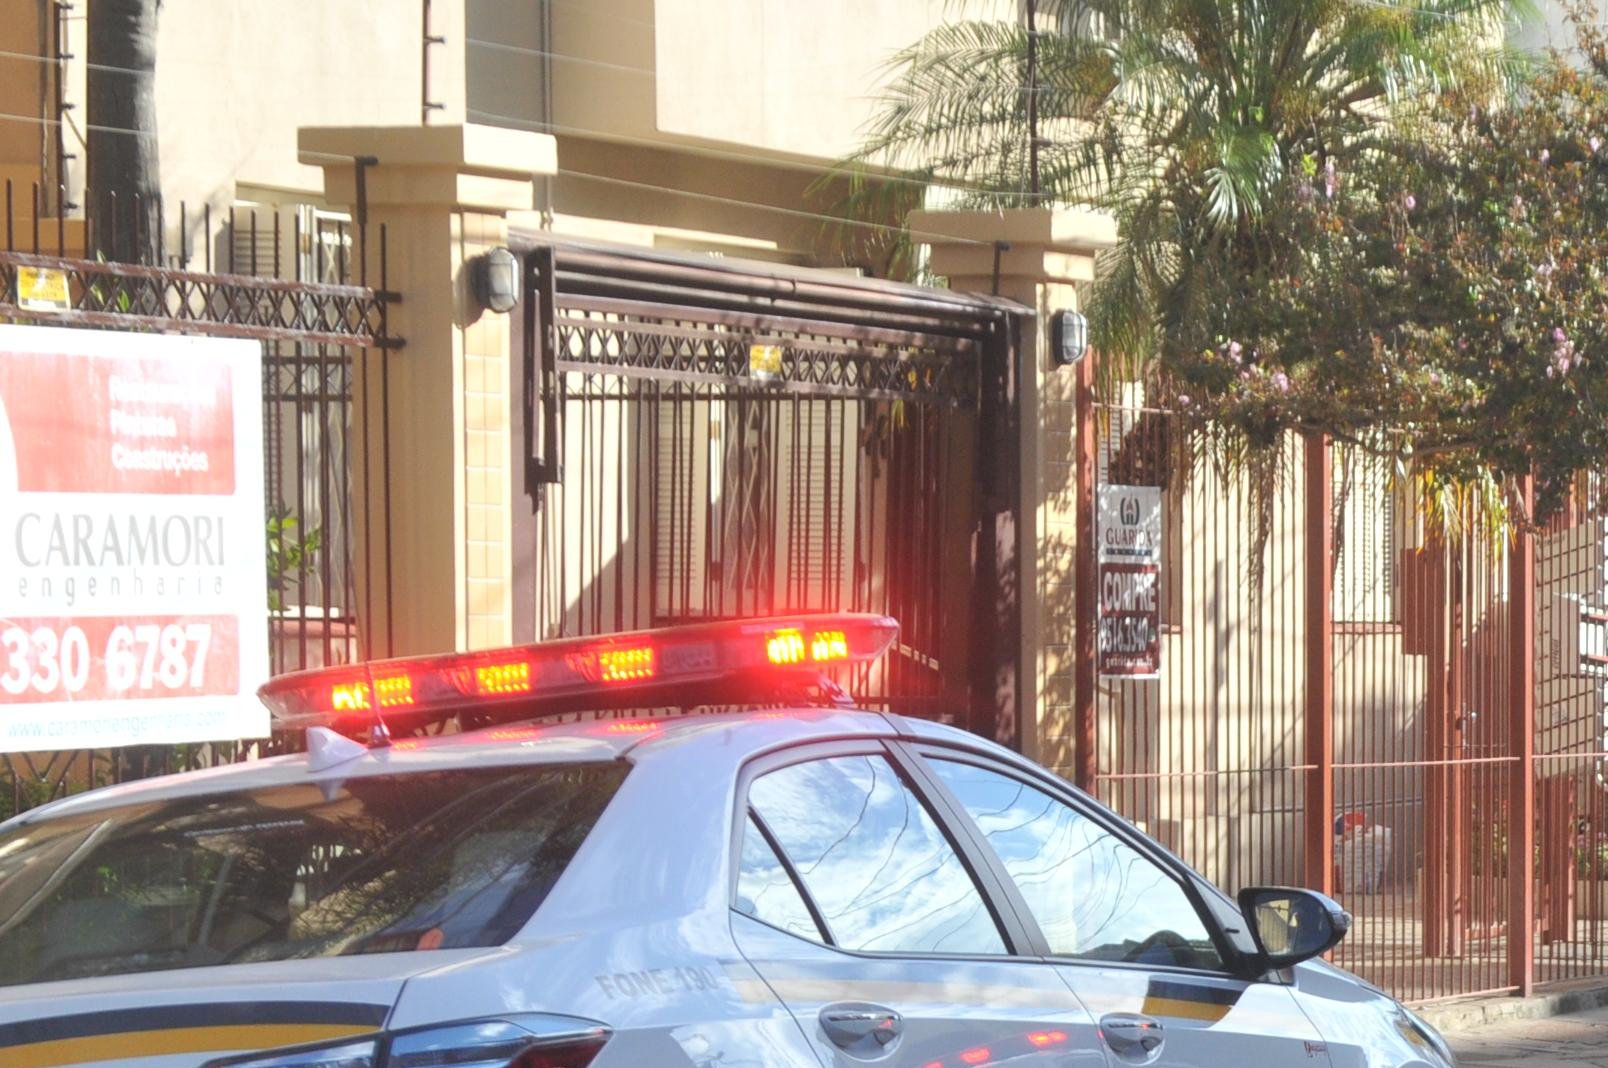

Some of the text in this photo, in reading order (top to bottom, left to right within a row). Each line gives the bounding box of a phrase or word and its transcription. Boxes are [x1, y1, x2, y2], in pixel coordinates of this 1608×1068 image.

[15, 512, 225, 567] CARAMORI
[19, 568, 222, 607] engenharia
[1103, 572, 1156, 611] COMPRE
[0, 623, 211, 693] 330 6787
